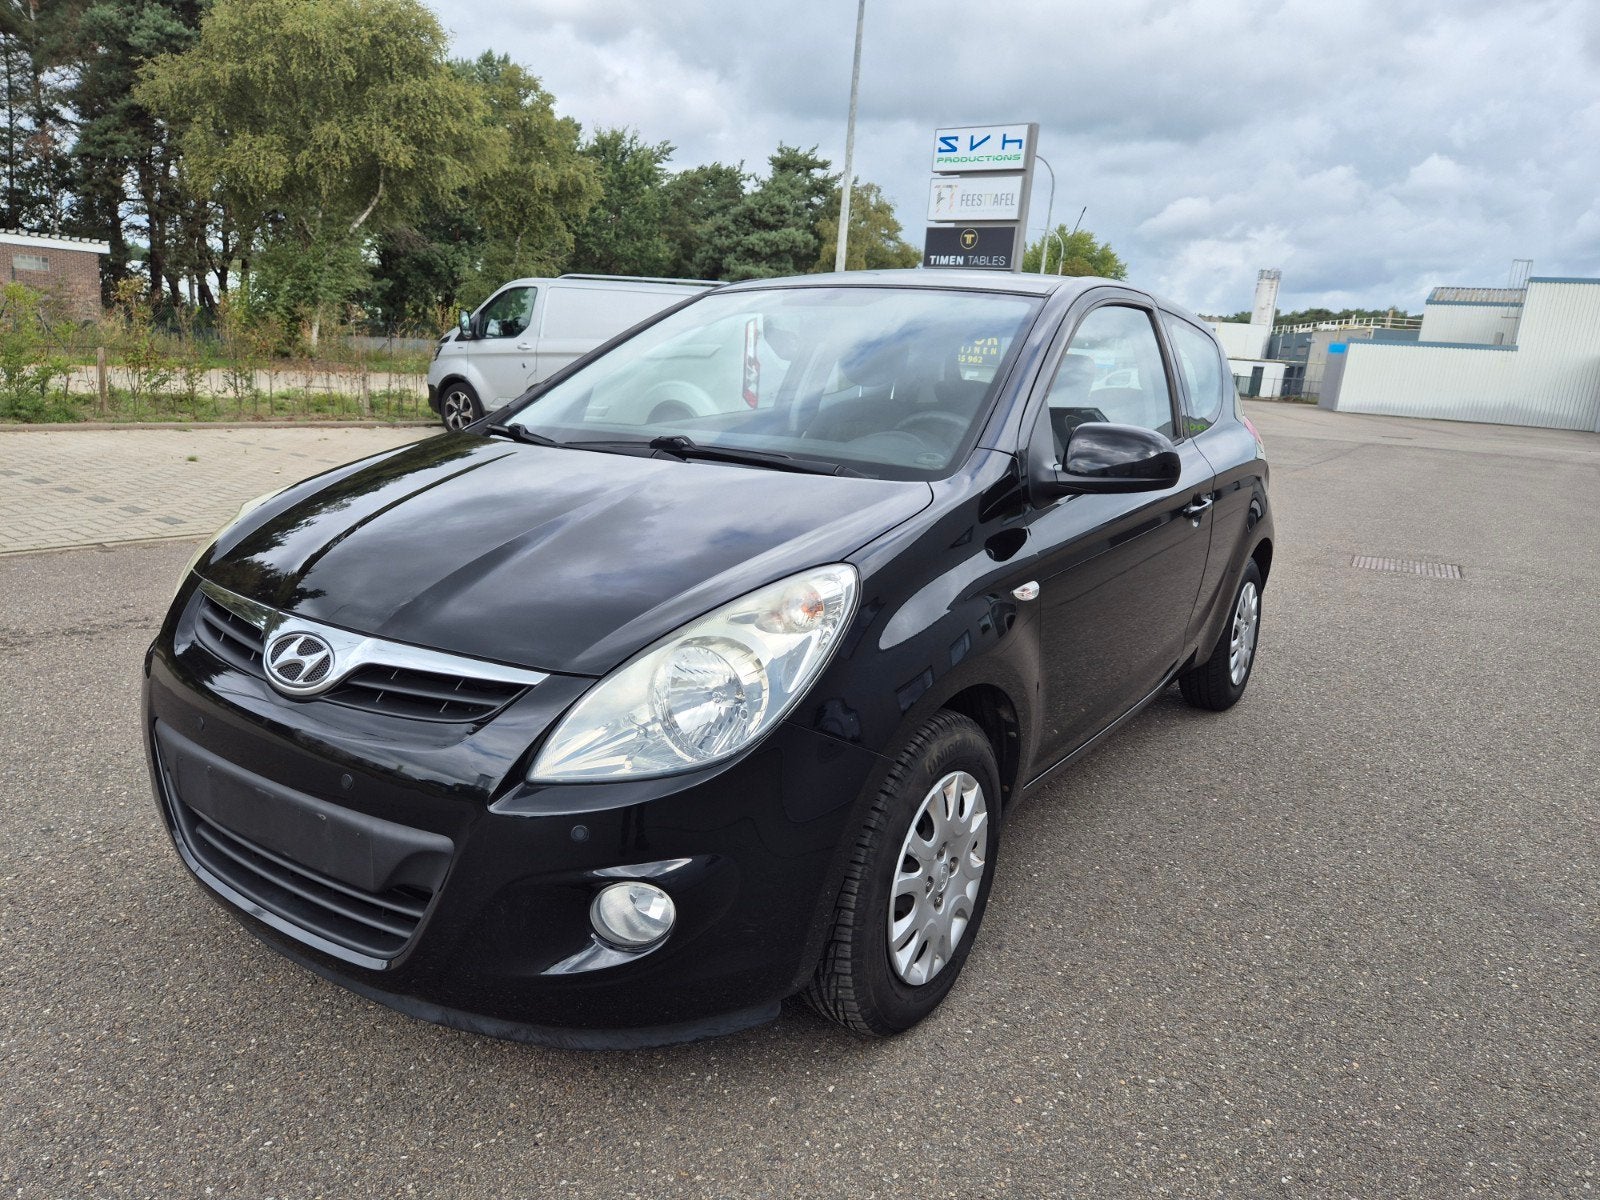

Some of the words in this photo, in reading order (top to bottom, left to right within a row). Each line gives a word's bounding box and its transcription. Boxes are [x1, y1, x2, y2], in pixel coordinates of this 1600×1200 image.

[936, 154, 1021, 163] PRODUCTIONS
[929, 255, 964, 265] TIMEN
[968, 255, 1007, 266] TABLES
